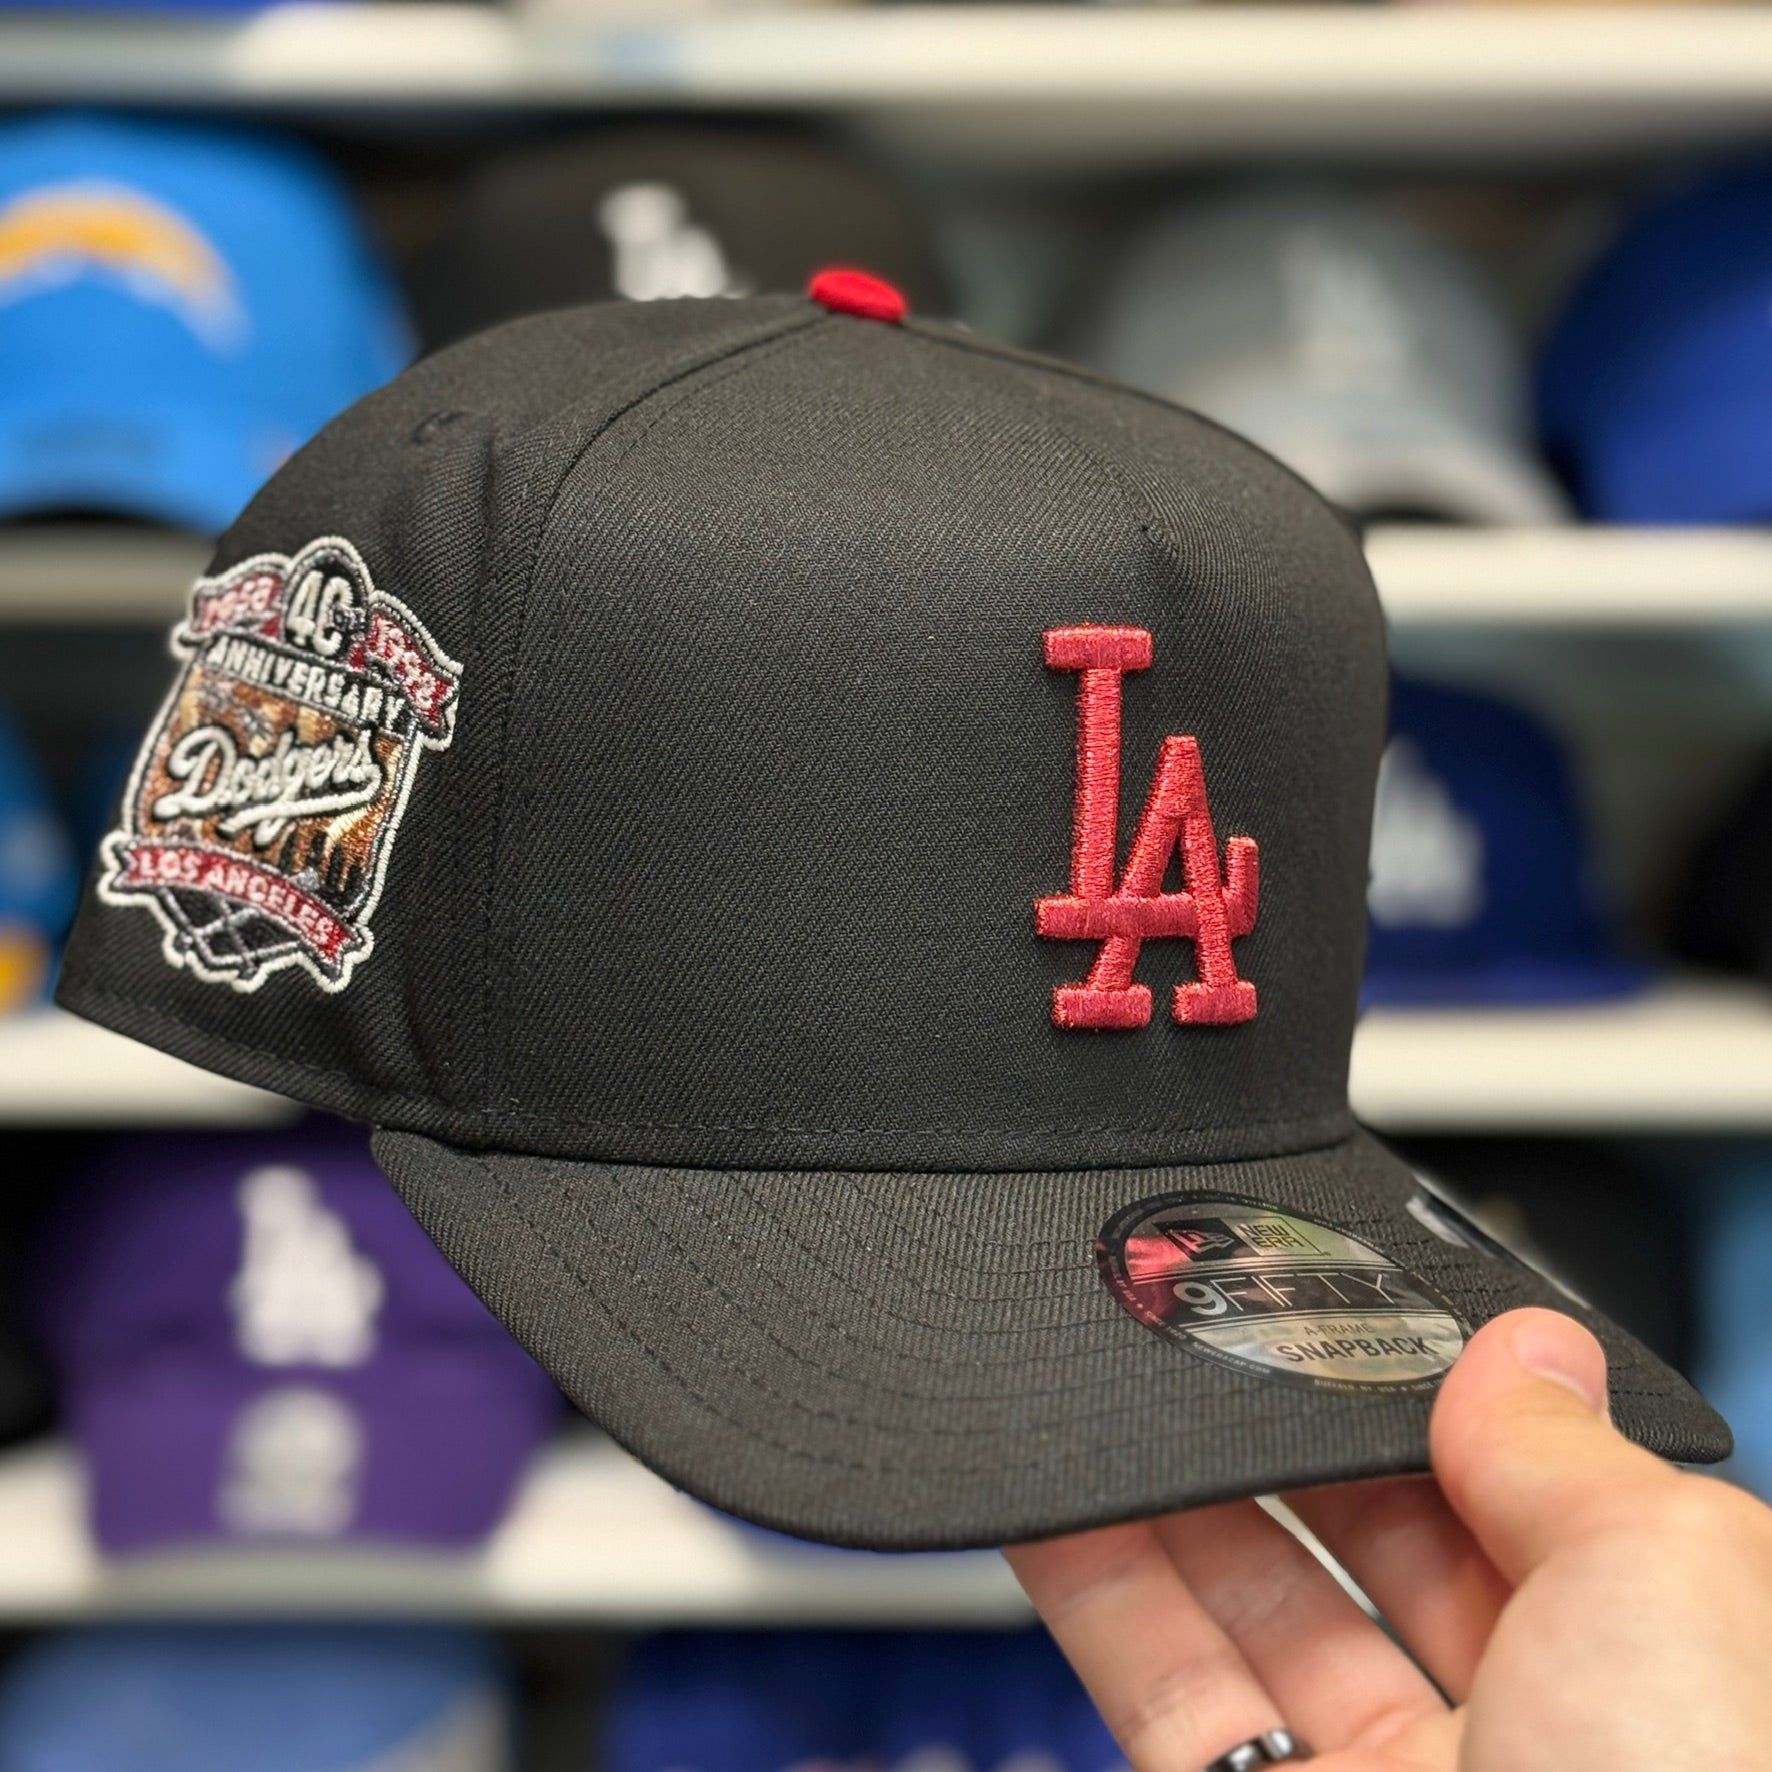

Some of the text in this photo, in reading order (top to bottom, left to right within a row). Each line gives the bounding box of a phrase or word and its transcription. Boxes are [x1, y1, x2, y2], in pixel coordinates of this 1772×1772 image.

[205, 634, 406, 732] ANNIVERSARY
[153, 725, 383, 847] Dodgers
[1034, 624, 1260, 1029] LA
[139, 850, 336, 945] LOS ANGELES
[1237, 1224, 1290, 1237] NEW
[1252, 1236, 1304, 1248] ERA
[1172, 1271, 1396, 1317] 9FIFTY
[1275, 1336, 1440, 1363] SNAPBACK
[1303, 1322, 1378, 1337] A-FRAME
